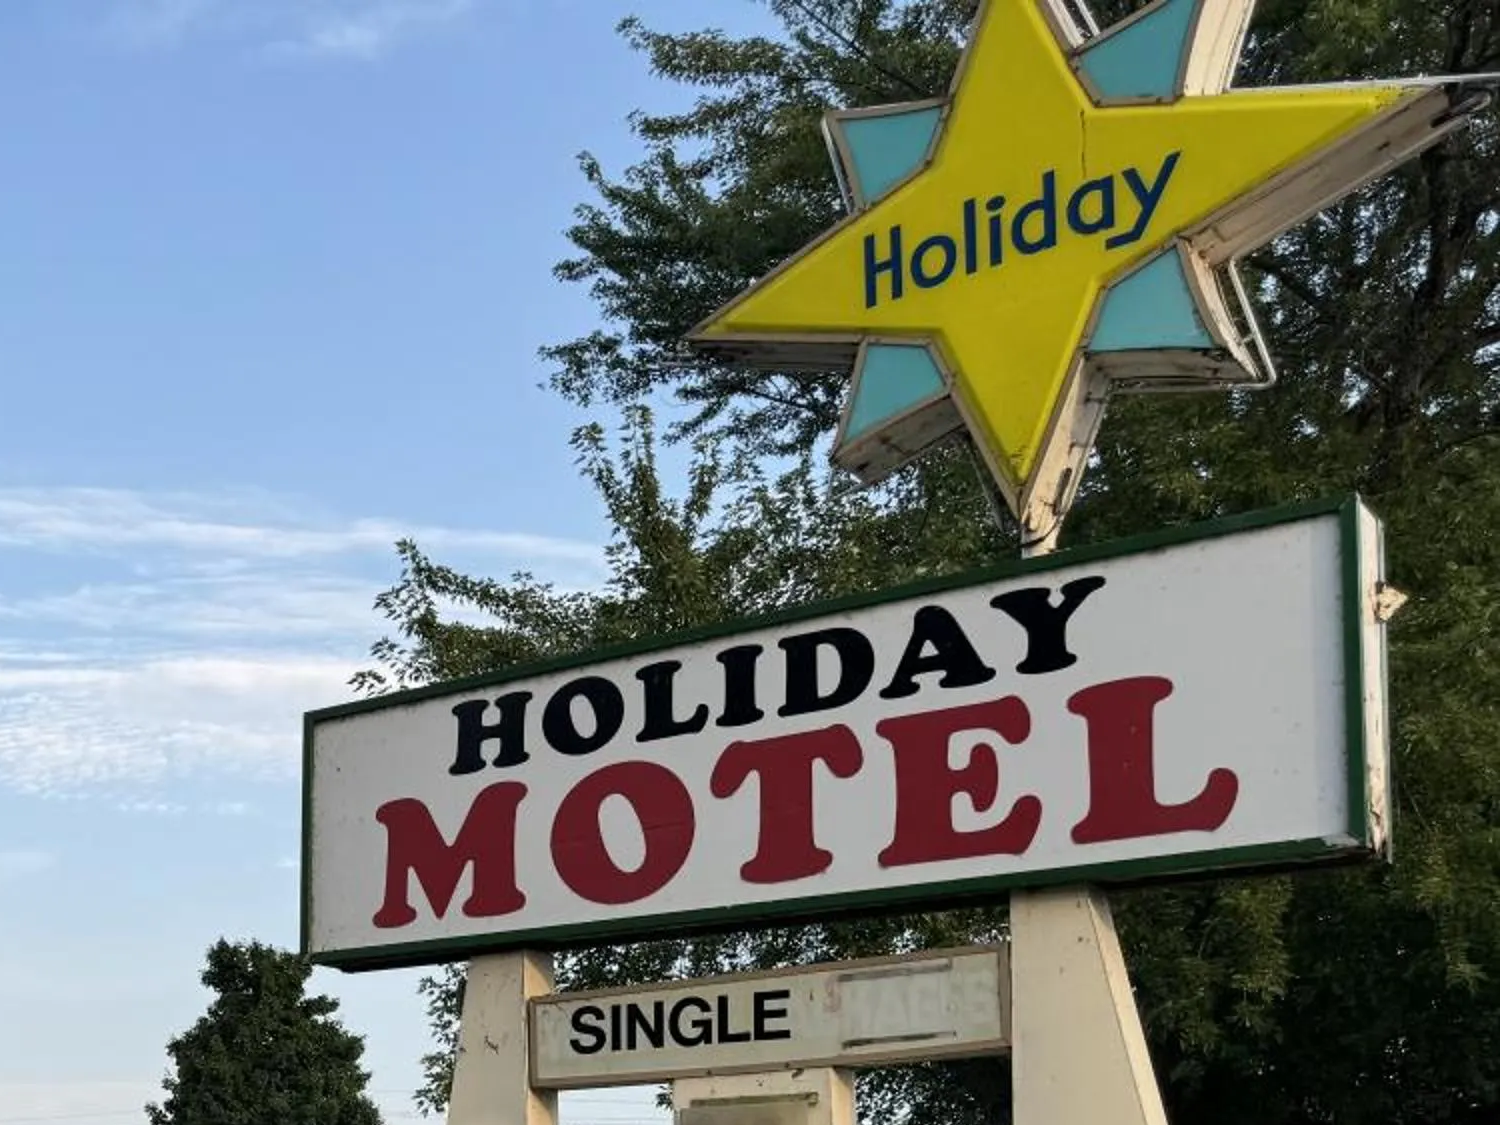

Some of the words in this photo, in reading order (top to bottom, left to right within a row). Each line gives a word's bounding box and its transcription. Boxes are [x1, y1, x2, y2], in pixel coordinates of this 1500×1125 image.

[863, 151, 1181, 308] Holiday
[448, 574, 1107, 776] HOLIDAY
[373, 675, 1239, 928] MOTEL
[568, 988, 792, 1055] SINGLE
